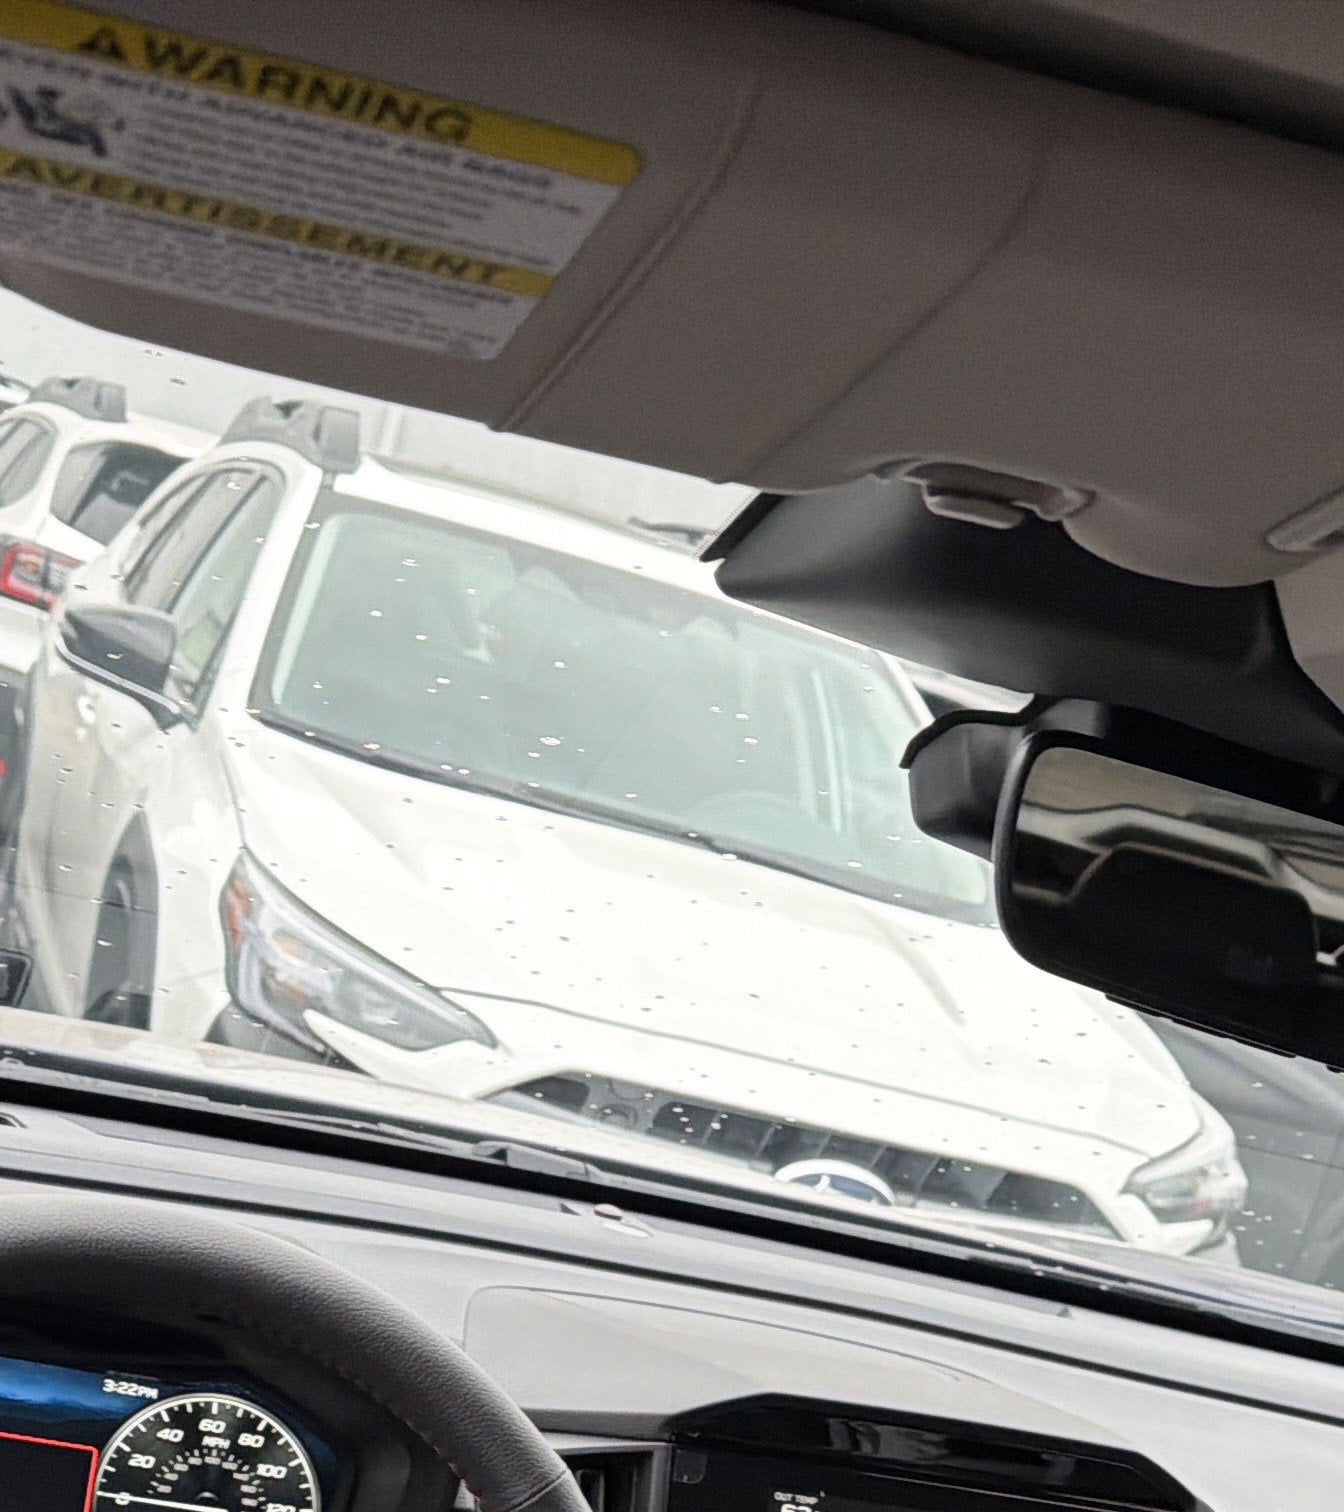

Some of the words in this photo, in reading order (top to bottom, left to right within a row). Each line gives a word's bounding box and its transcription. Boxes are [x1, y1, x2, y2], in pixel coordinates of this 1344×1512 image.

[143, 36, 474, 143] WARNING
[24, 152, 505, 285] AVERTISSEMENT
[198, 1418, 227, 1434] 60
[156, 1427, 185, 1443] 40
[201, 1436, 231, 1449] MPH
[238, 1433, 265, 1448] 80
[128, 1453, 156, 1469] 20
[256, 1463, 288, 1479] 100
